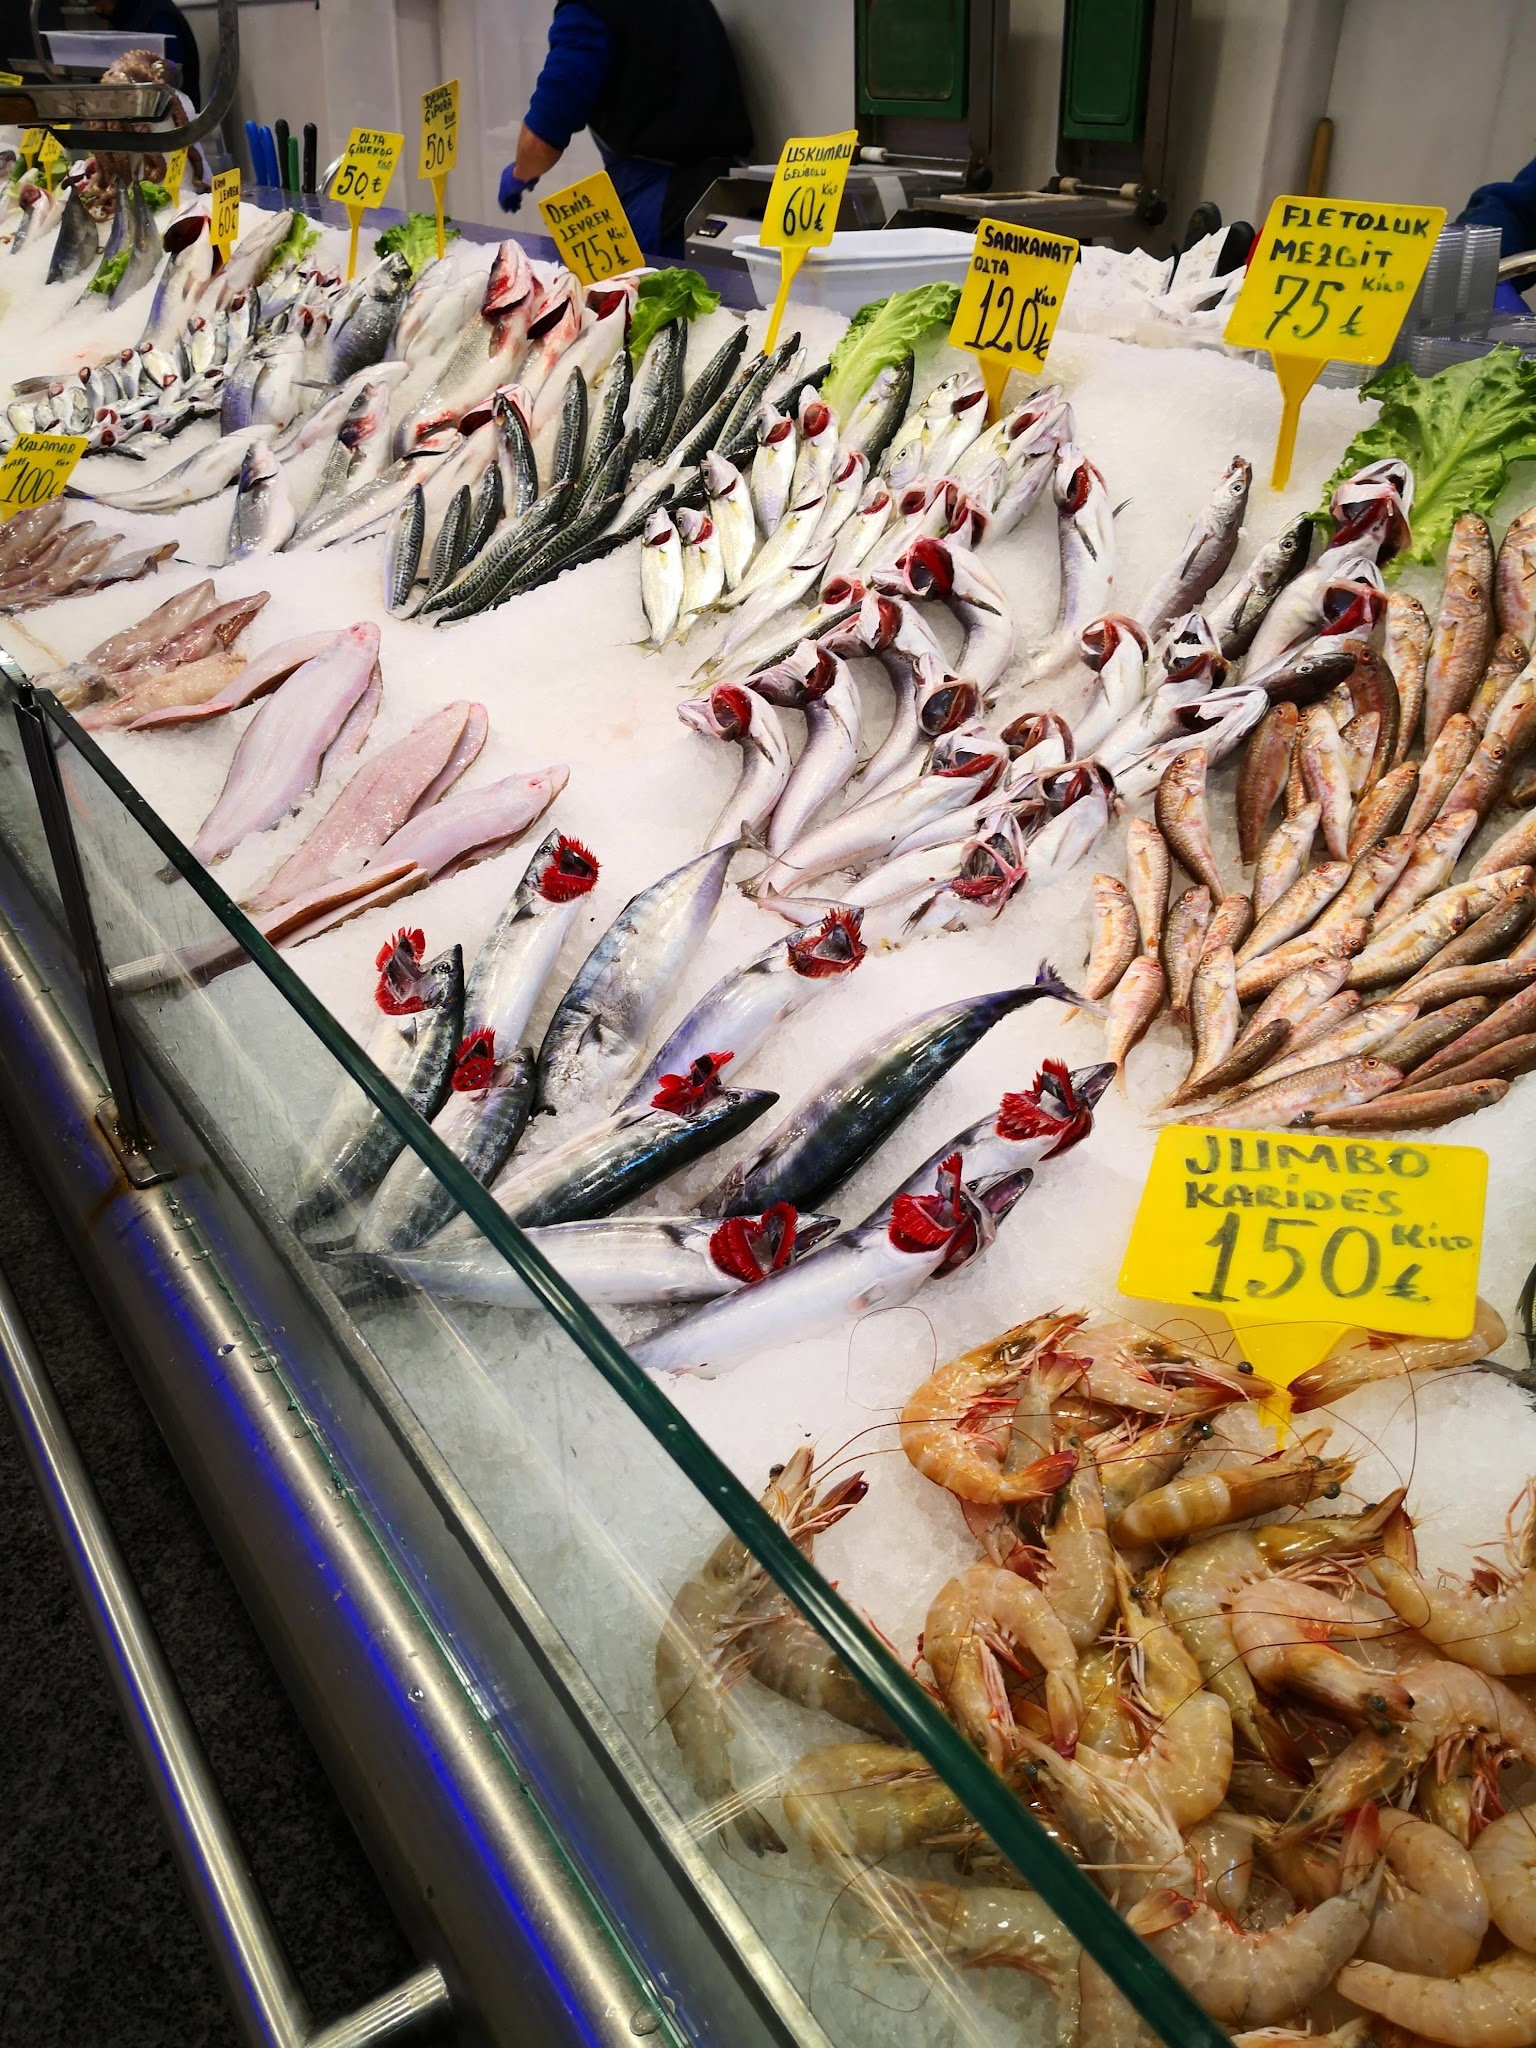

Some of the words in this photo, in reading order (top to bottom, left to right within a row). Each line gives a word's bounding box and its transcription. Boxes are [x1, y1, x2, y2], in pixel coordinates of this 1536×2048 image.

[359, 133, 385, 146] OLTA
[425, 133, 445, 170] 50
[786, 144, 852, 163] USKUMRU
[337, 165, 369, 196] 50
[218, 206, 231, 237] 60
[559, 208, 614, 243] LEVREK
[782, 186, 816, 237] 60
[571, 234, 613, 282] 75
[982, 225, 1075, 265] SARIKANAT
[973, 255, 1010, 276] OLTA
[964, 279, 1039, 354] 120
[1264, 274, 1345, 341] 75
[15, 436, 77, 454] KALAMAR
[0, 461, 55, 504] 100
[1185, 1135, 1431, 1179] JUMBO
[1185, 1173, 1404, 1217] KARİDES
[1192, 1210, 1382, 1303] 150
